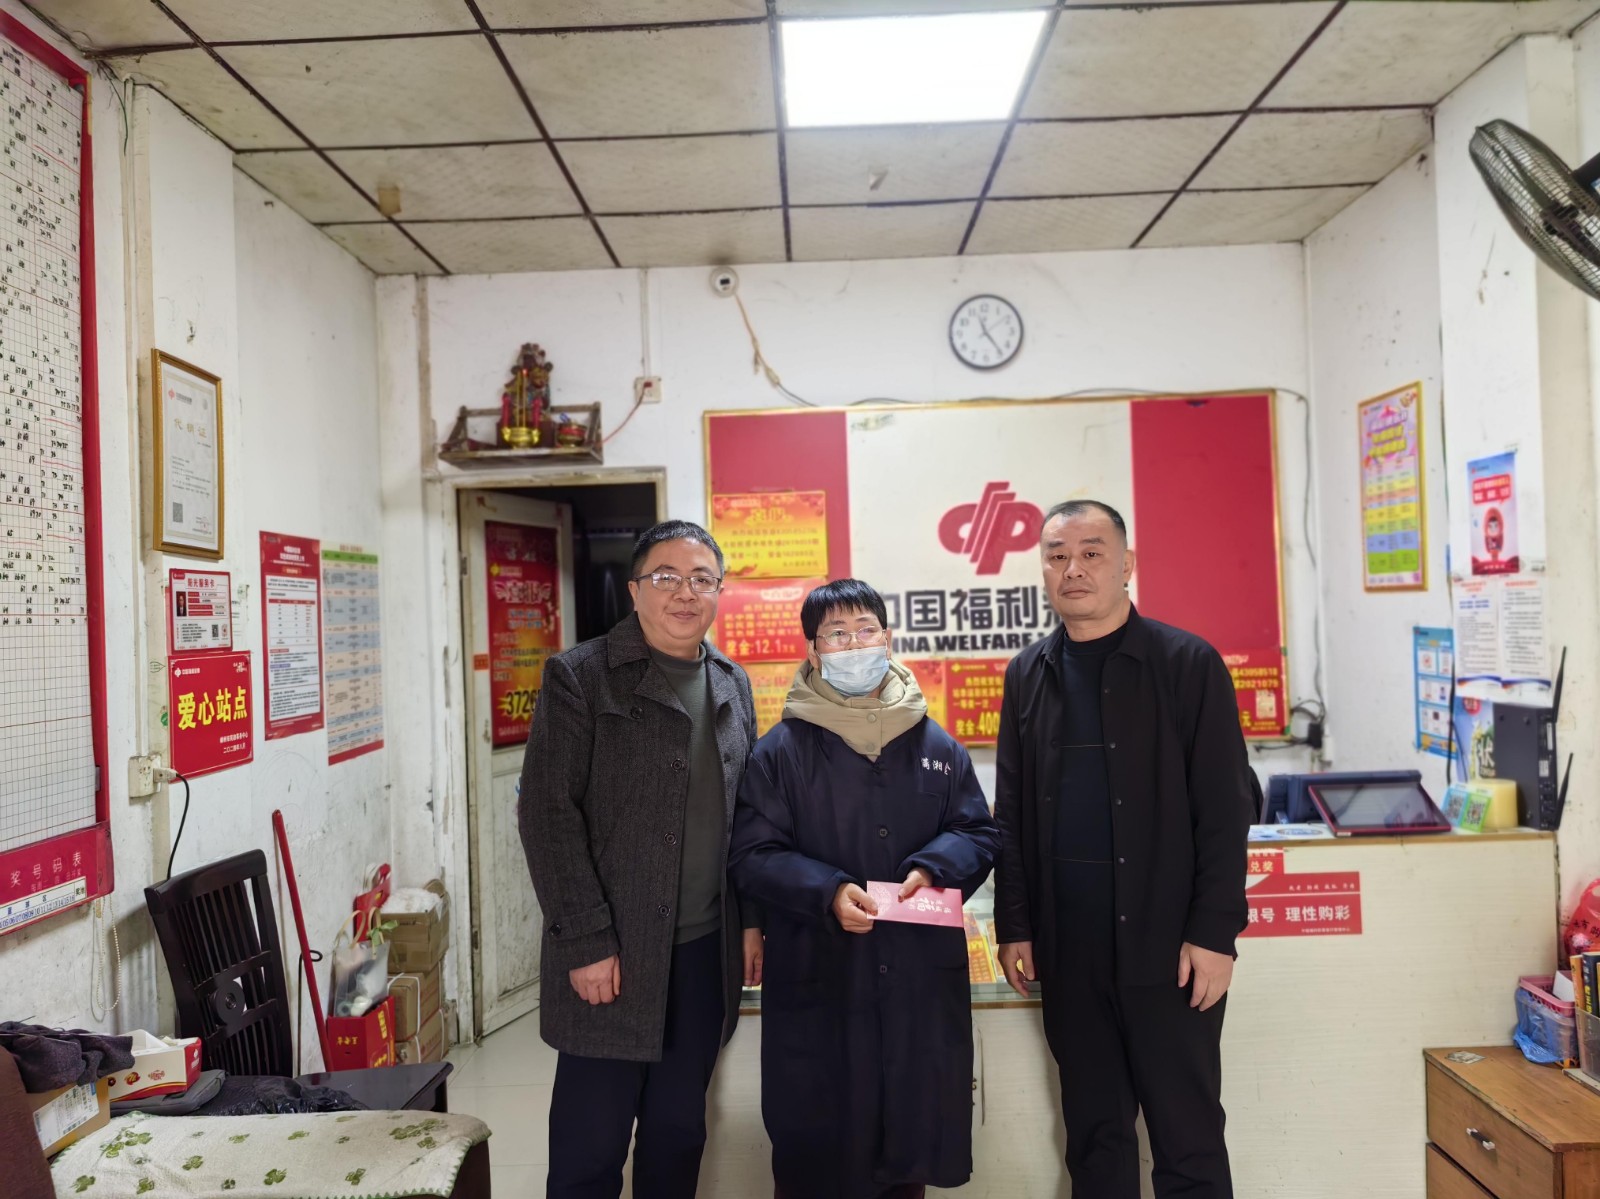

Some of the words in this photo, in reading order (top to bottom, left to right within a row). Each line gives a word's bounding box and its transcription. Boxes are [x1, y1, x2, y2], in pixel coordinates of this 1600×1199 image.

[187, 577, 215, 589] 阳光服务卡
[178, 685, 248, 731] 爱心站点
[505, 688, 541, 716] 3726
[1250, 861, 1274, 873] 兑奖
[1285, 905, 1350, 922] 理性购彩
